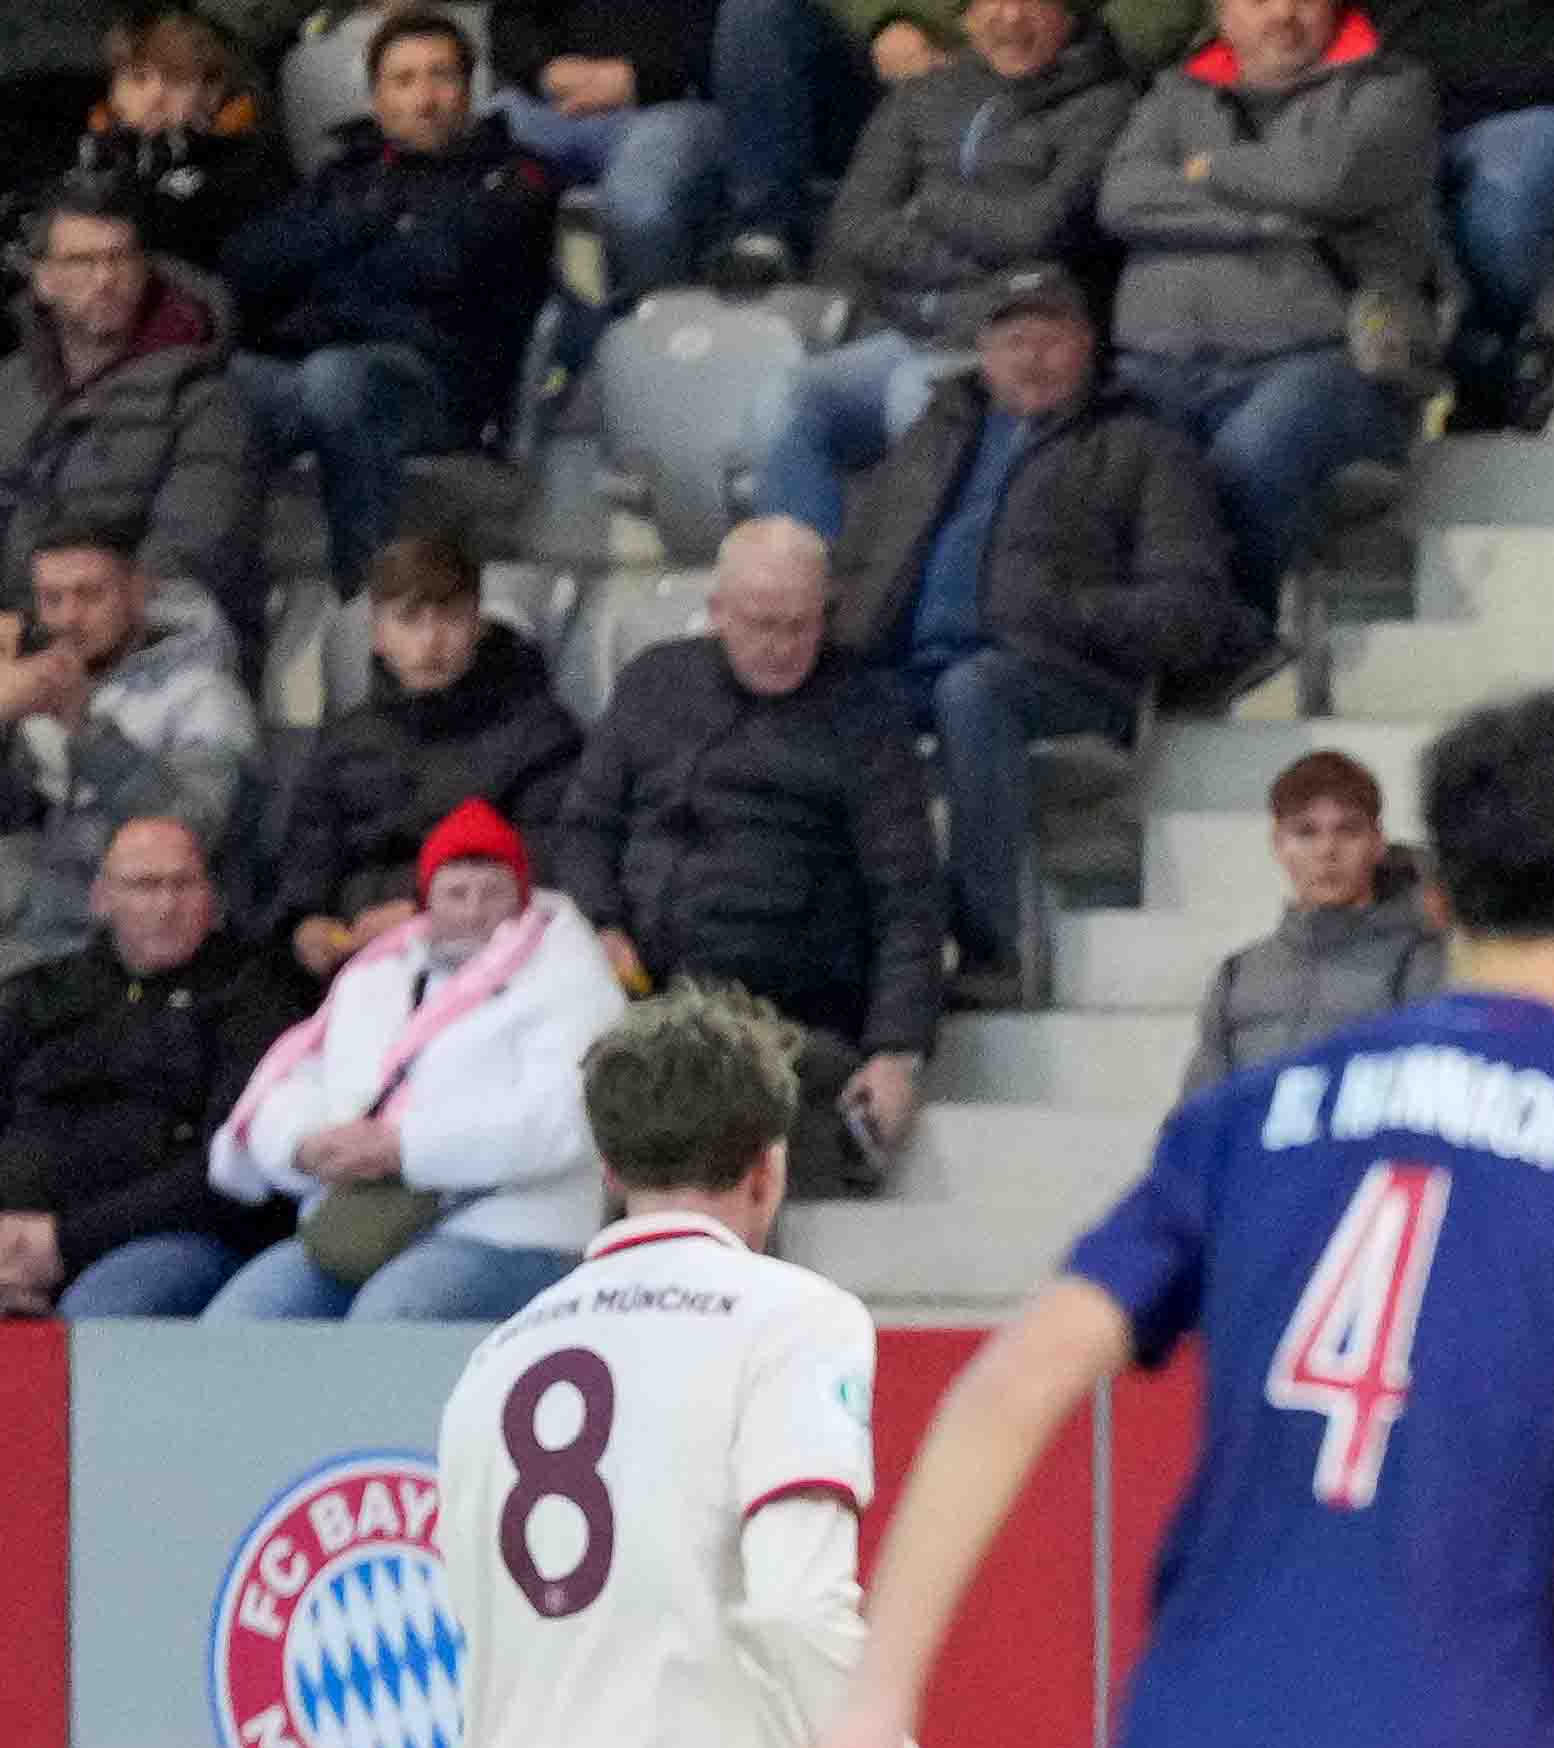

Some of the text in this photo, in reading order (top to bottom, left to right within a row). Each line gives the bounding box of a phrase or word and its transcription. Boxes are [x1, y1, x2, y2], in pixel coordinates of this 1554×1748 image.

[1266, 1160, 1454, 1512] 4
[239, 1535, 310, 1641] FC
[501, 1347, 616, 1619] 8
